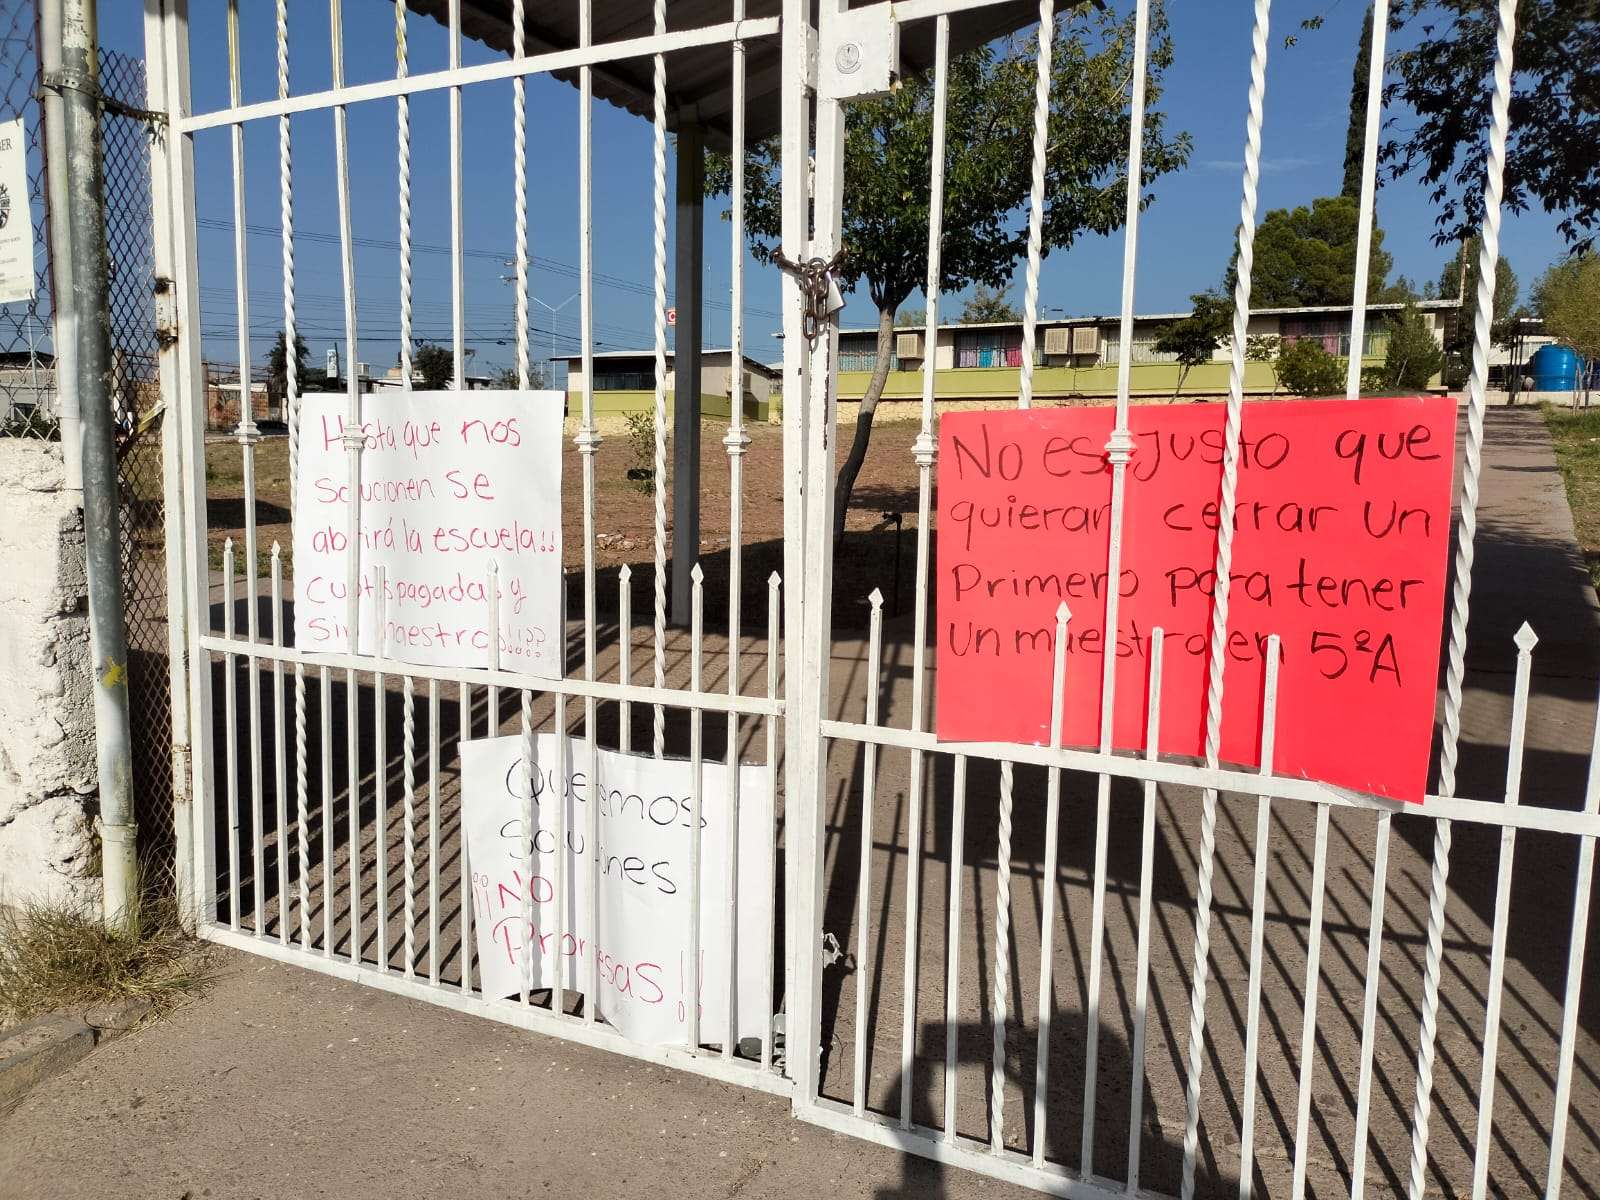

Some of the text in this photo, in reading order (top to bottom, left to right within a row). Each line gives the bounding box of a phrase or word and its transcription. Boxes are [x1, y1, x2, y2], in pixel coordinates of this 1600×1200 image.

[321, 414, 521, 461] Hsta que nos
[952, 423, 1023, 481] No
[1043, 436, 1109, 476] es
[1335, 425, 1441, 485] que
[312, 516, 396, 554] abirá
[511, 577, 527, 614] y
[1286, 558, 1424, 611] tener
[505, 757, 707, 829] Queemos
